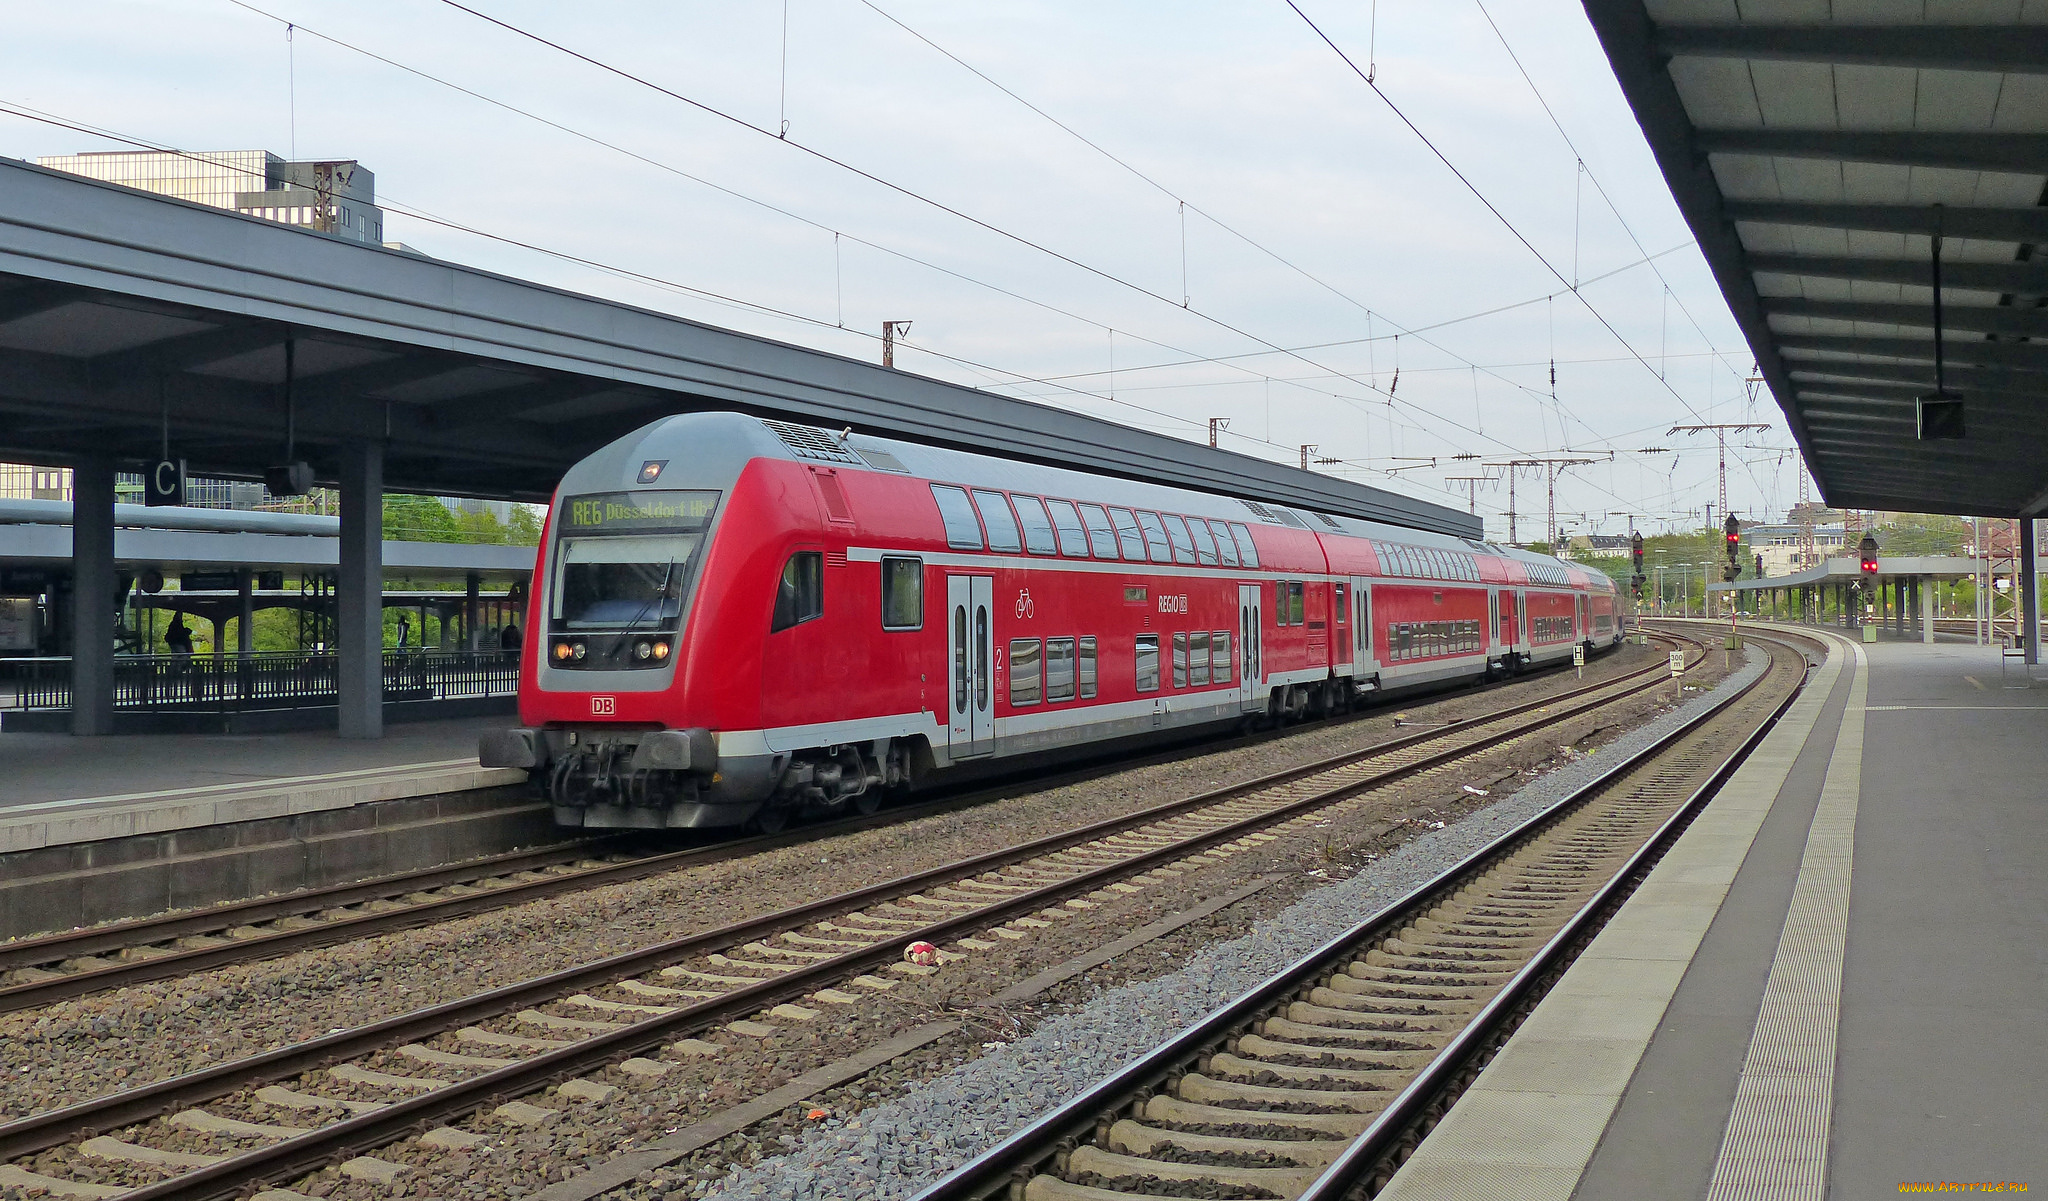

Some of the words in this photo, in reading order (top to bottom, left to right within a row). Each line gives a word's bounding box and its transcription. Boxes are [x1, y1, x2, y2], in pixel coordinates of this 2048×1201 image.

[156, 461, 175, 495] C
[573, 500, 602, 525] RE6
[606, 501, 685, 521] Düsseldorf
[1158, 595, 1178, 613] REGIO
[1234, 637, 1239, 653] 2
[1574, 647, 1583, 659] H
[996, 648, 1002, 670] 2
[593, 698, 614, 713] DB
